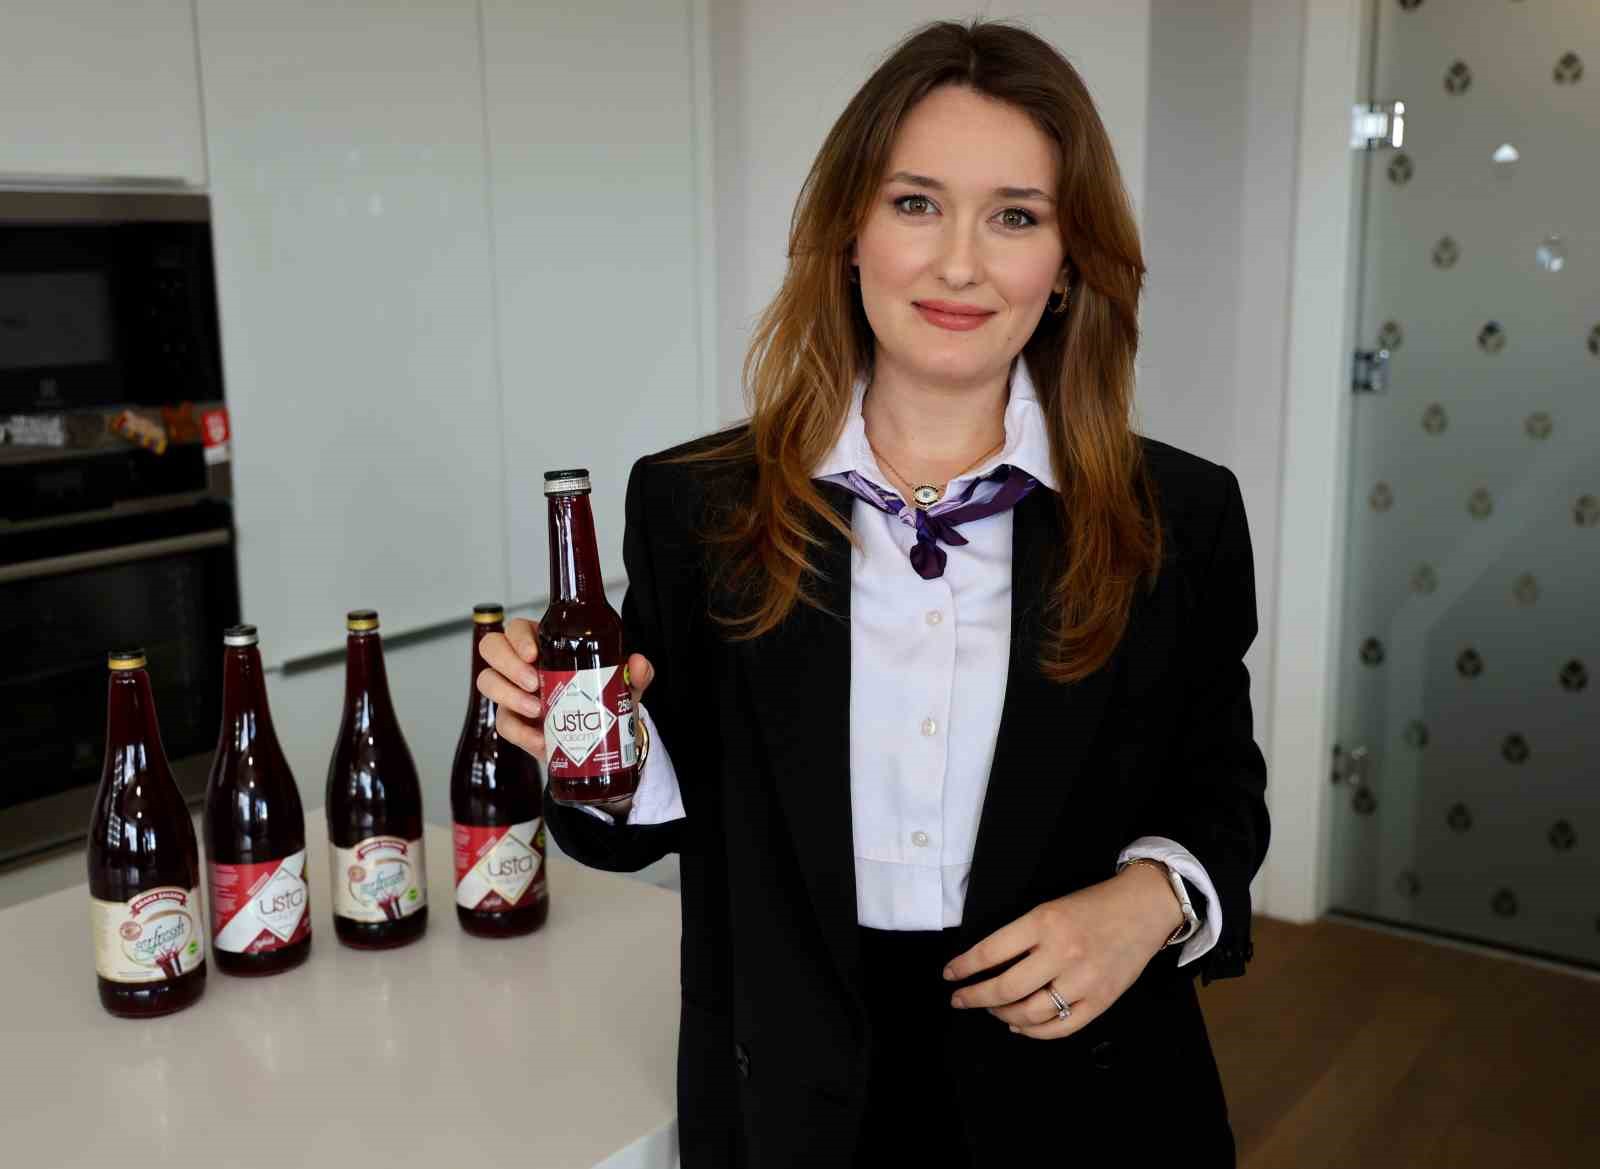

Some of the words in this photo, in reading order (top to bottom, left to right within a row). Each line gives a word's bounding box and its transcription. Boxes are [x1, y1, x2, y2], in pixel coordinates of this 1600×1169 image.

[552, 709, 602, 732] usta
[488, 855, 533, 877] usta
[259, 888, 304, 916] usta
